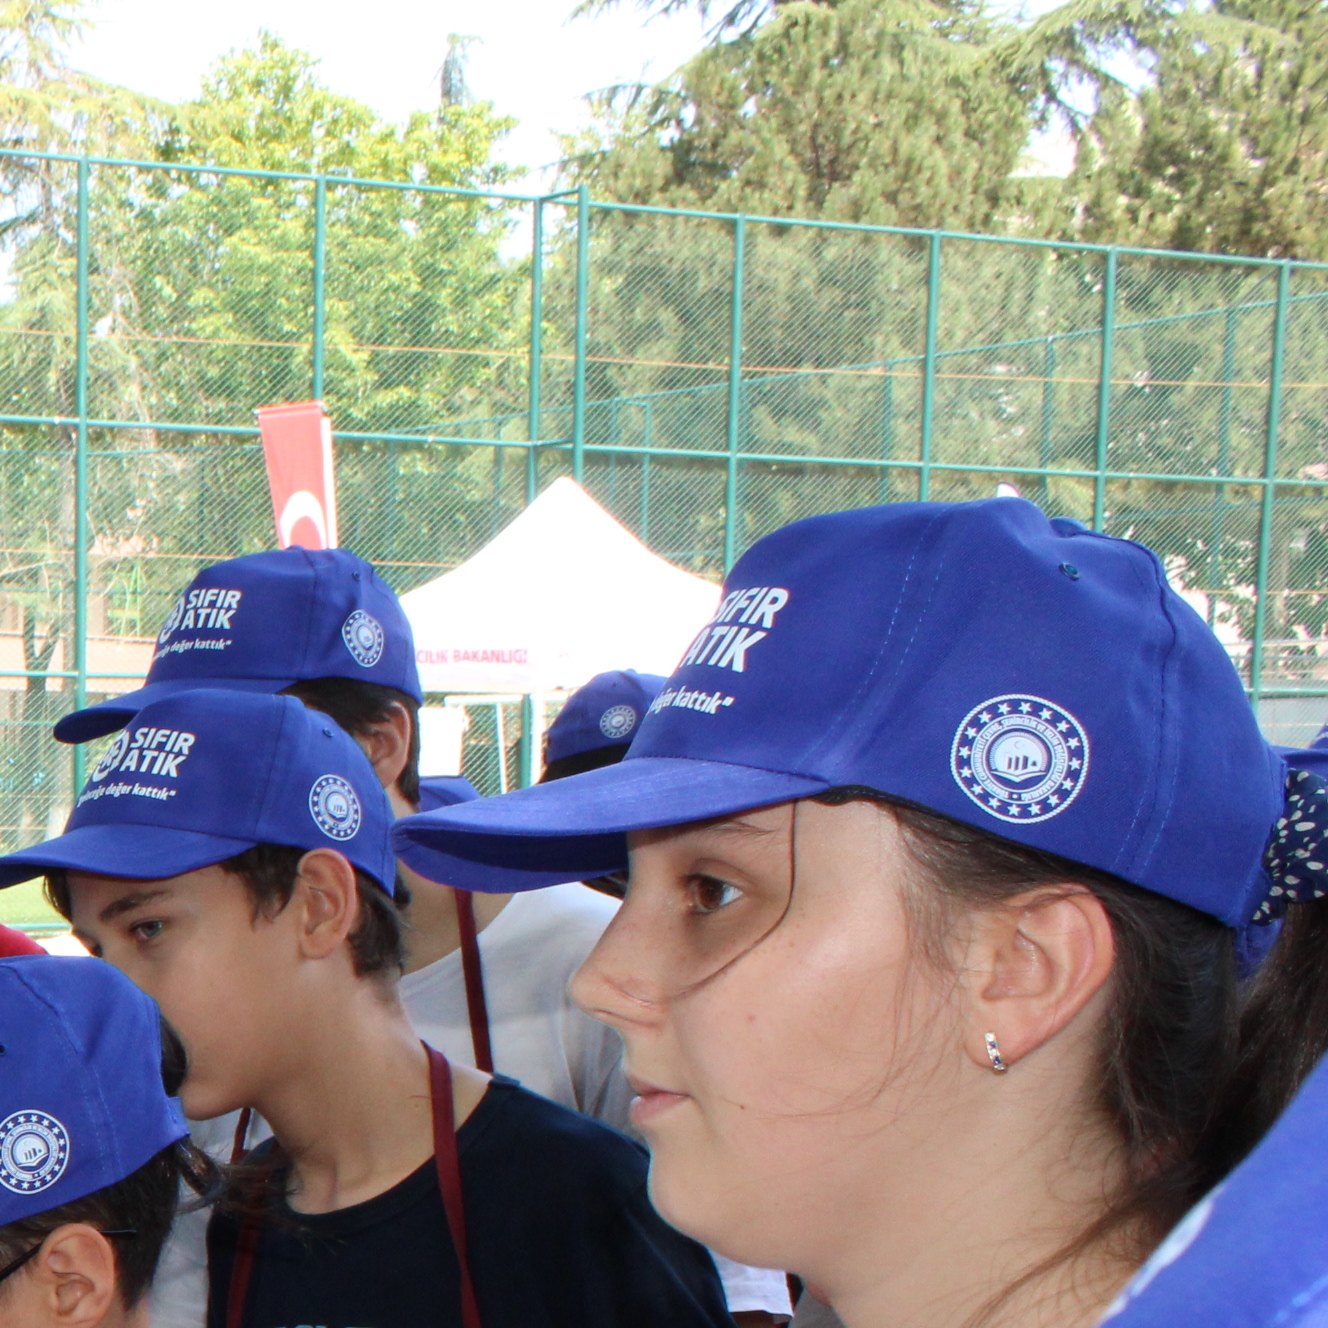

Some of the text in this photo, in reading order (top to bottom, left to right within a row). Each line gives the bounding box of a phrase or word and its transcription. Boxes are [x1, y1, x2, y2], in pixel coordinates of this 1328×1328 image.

[186, 587, 242, 609] SIFIR
[707, 586, 789, 629] SIFIR
[180, 607, 238, 631] ATIK
[678, 625, 768, 673] ATIK
[130, 727, 196, 756] SIFIR
[119, 748, 188, 778] ATIK
